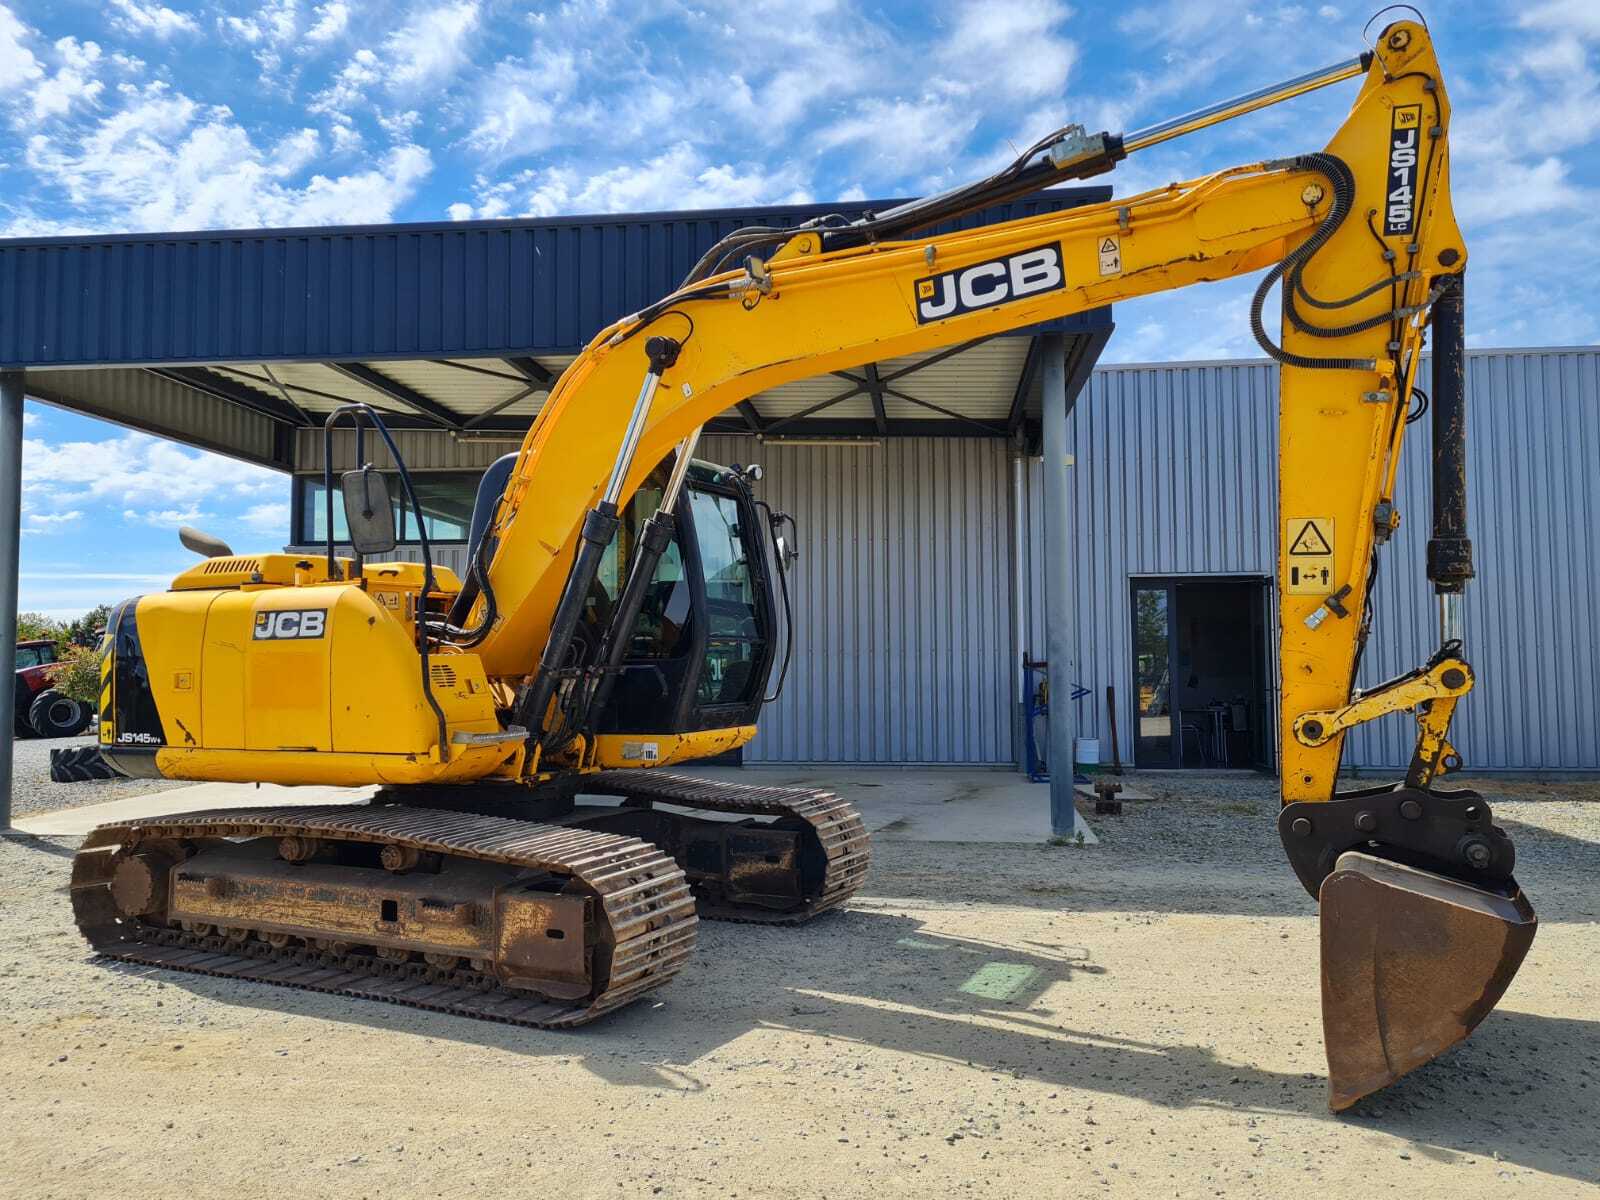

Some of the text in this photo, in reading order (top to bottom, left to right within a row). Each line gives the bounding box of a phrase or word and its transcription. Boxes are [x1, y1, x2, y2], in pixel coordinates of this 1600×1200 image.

[1388, 129, 1416, 231] JS145 LC
[920, 248, 1061, 318] JCB
[255, 611, 325, 638] JCB
